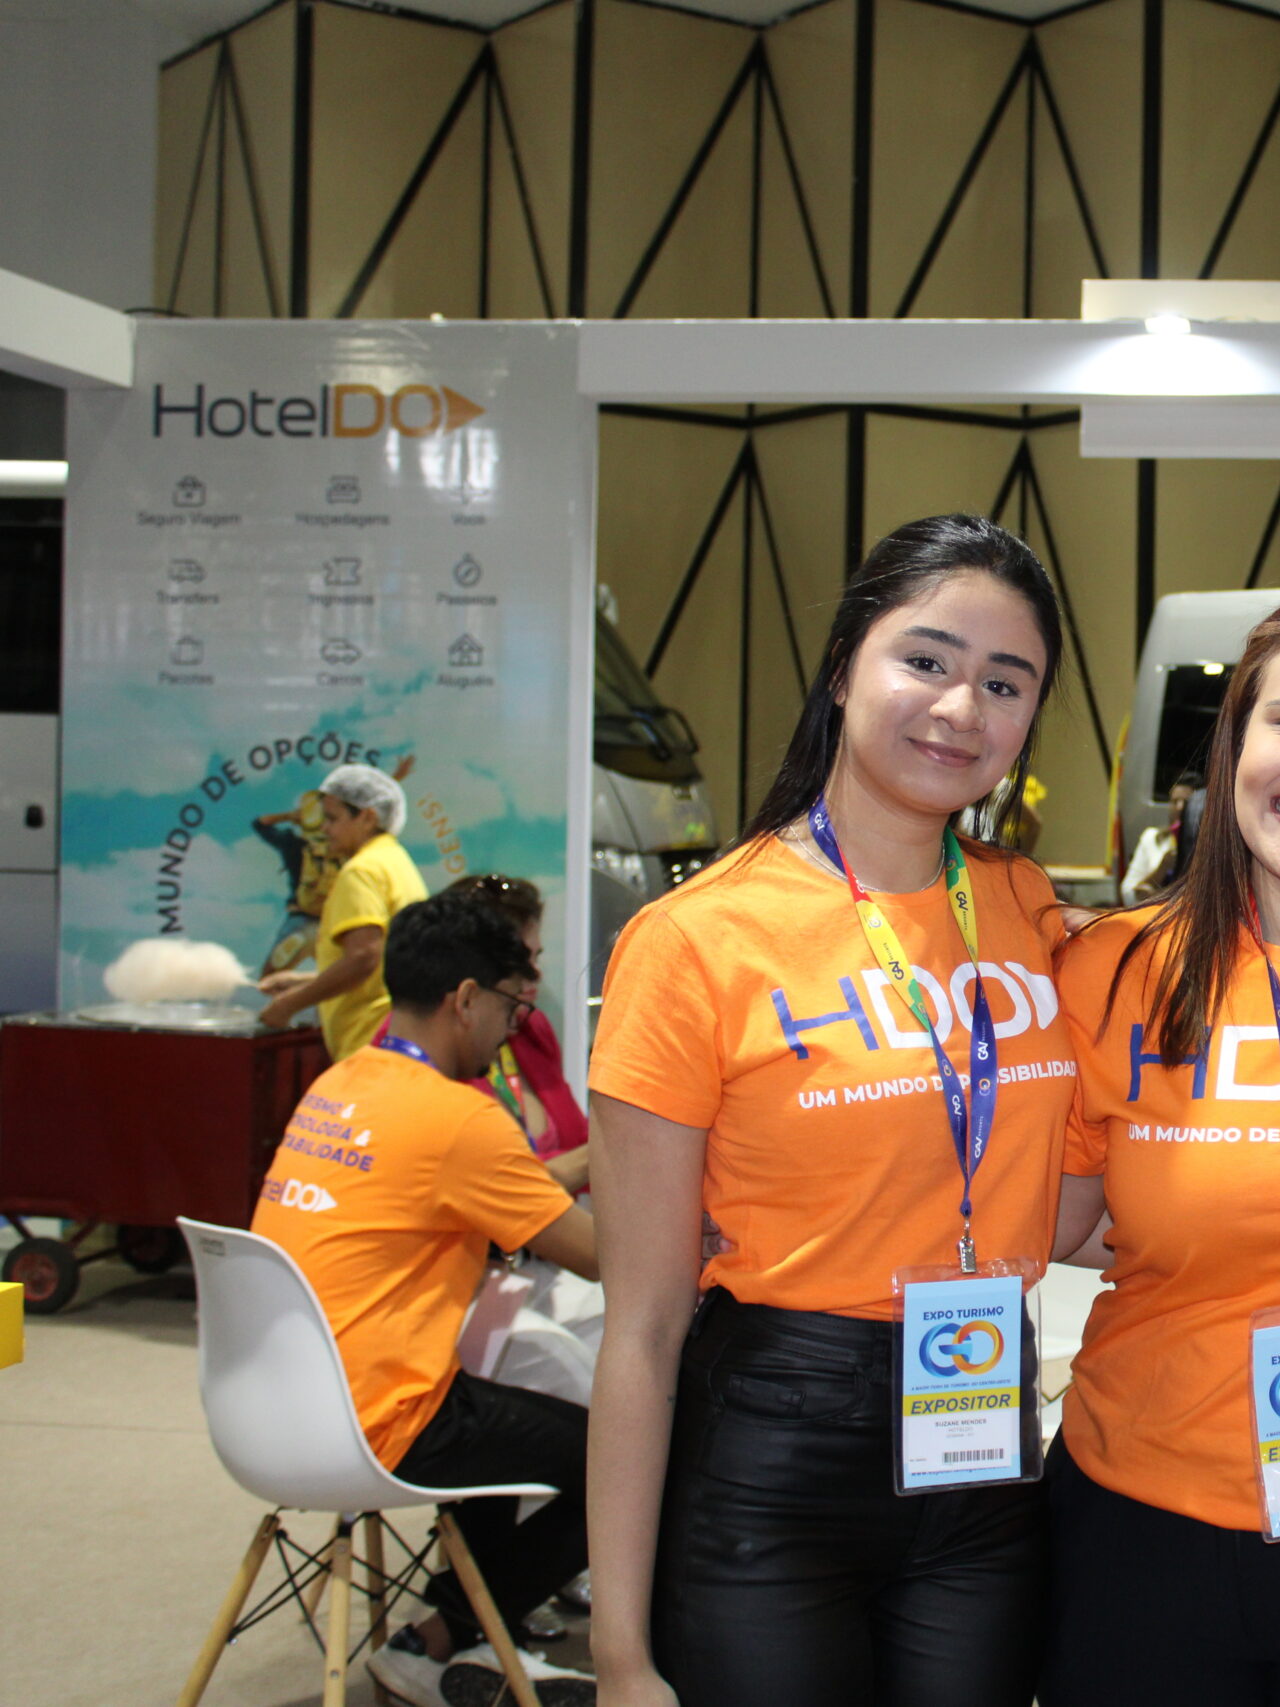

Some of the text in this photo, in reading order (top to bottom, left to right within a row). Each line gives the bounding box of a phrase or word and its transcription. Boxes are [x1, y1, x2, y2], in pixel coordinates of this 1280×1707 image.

[153, 383, 442, 439] HotelDO
[155, 731, 381, 936] MUNDO DE OPÇÕES
[416, 793, 467, 875] GENS!
[770, 961, 1032, 1060] HDO
[799, 1088, 837, 1110] UM
[844, 1075, 928, 1105] MUNDO
[1128, 1123, 1150, 1142] UM
[1155, 1126, 1242, 1143] MUNDO
[923, 1305, 1005, 1321] EXPO TURISMO
[911, 1393, 1012, 1416] EXPOSITOR
